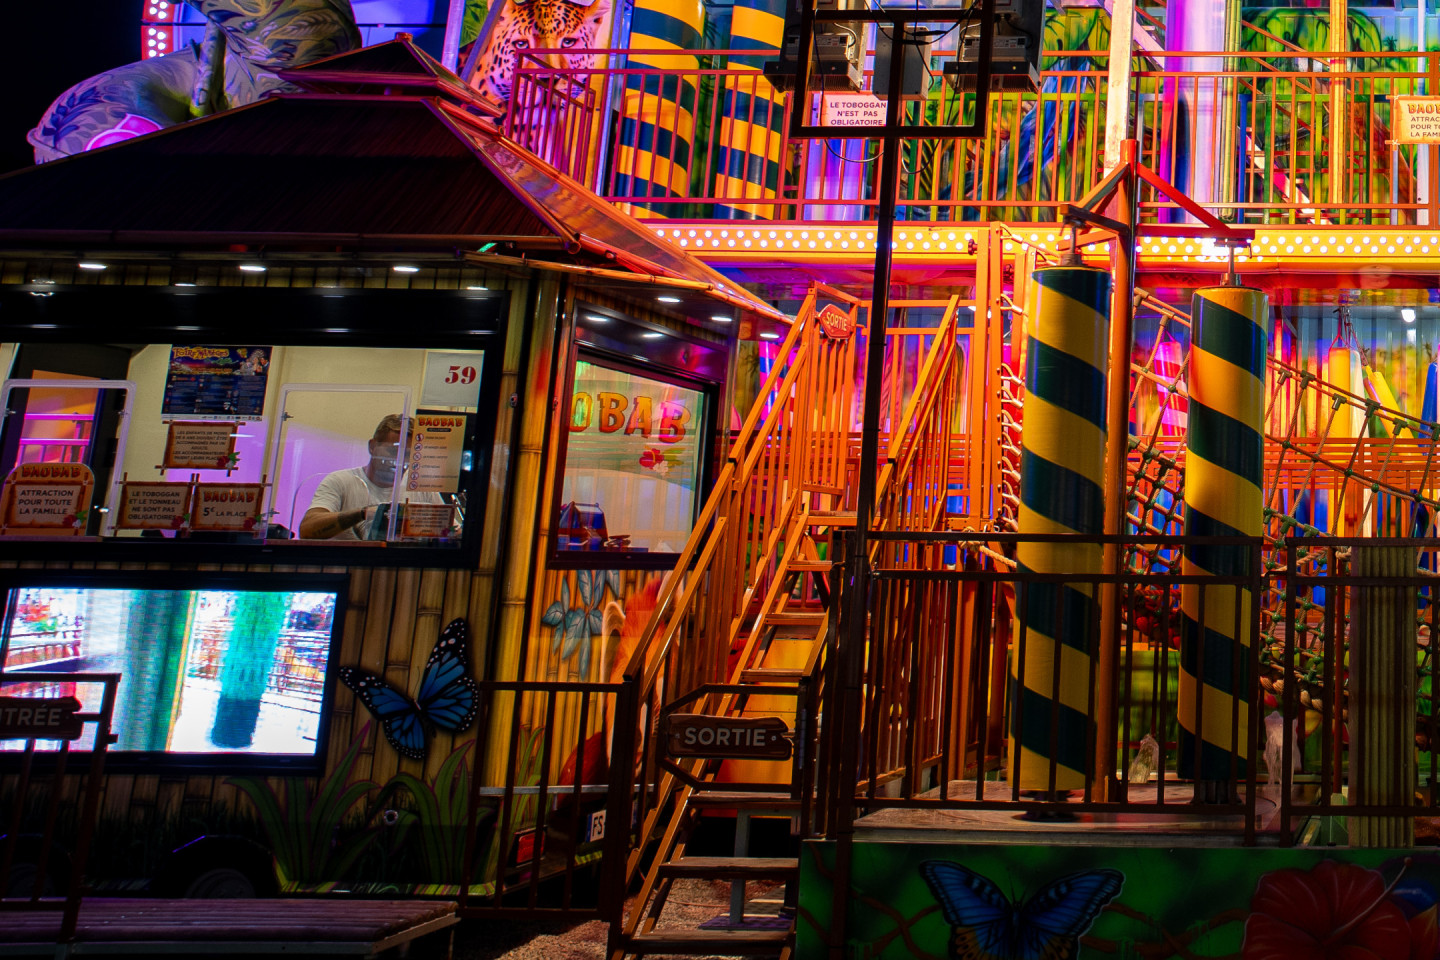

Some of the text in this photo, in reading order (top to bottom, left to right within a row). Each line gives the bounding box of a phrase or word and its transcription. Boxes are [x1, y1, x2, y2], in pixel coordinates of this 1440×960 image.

[829, 101, 887, 109] LE TOBOGGAN
[826, 311, 848, 332] SORTIE
[444, 365, 477, 385] 59
[21, 466, 81, 478] BAOBAB
[203, 491, 256, 502] BAOBAB
[0, 704, 62, 726] TRÉE
[684, 727, 767, 747] SORTIE
